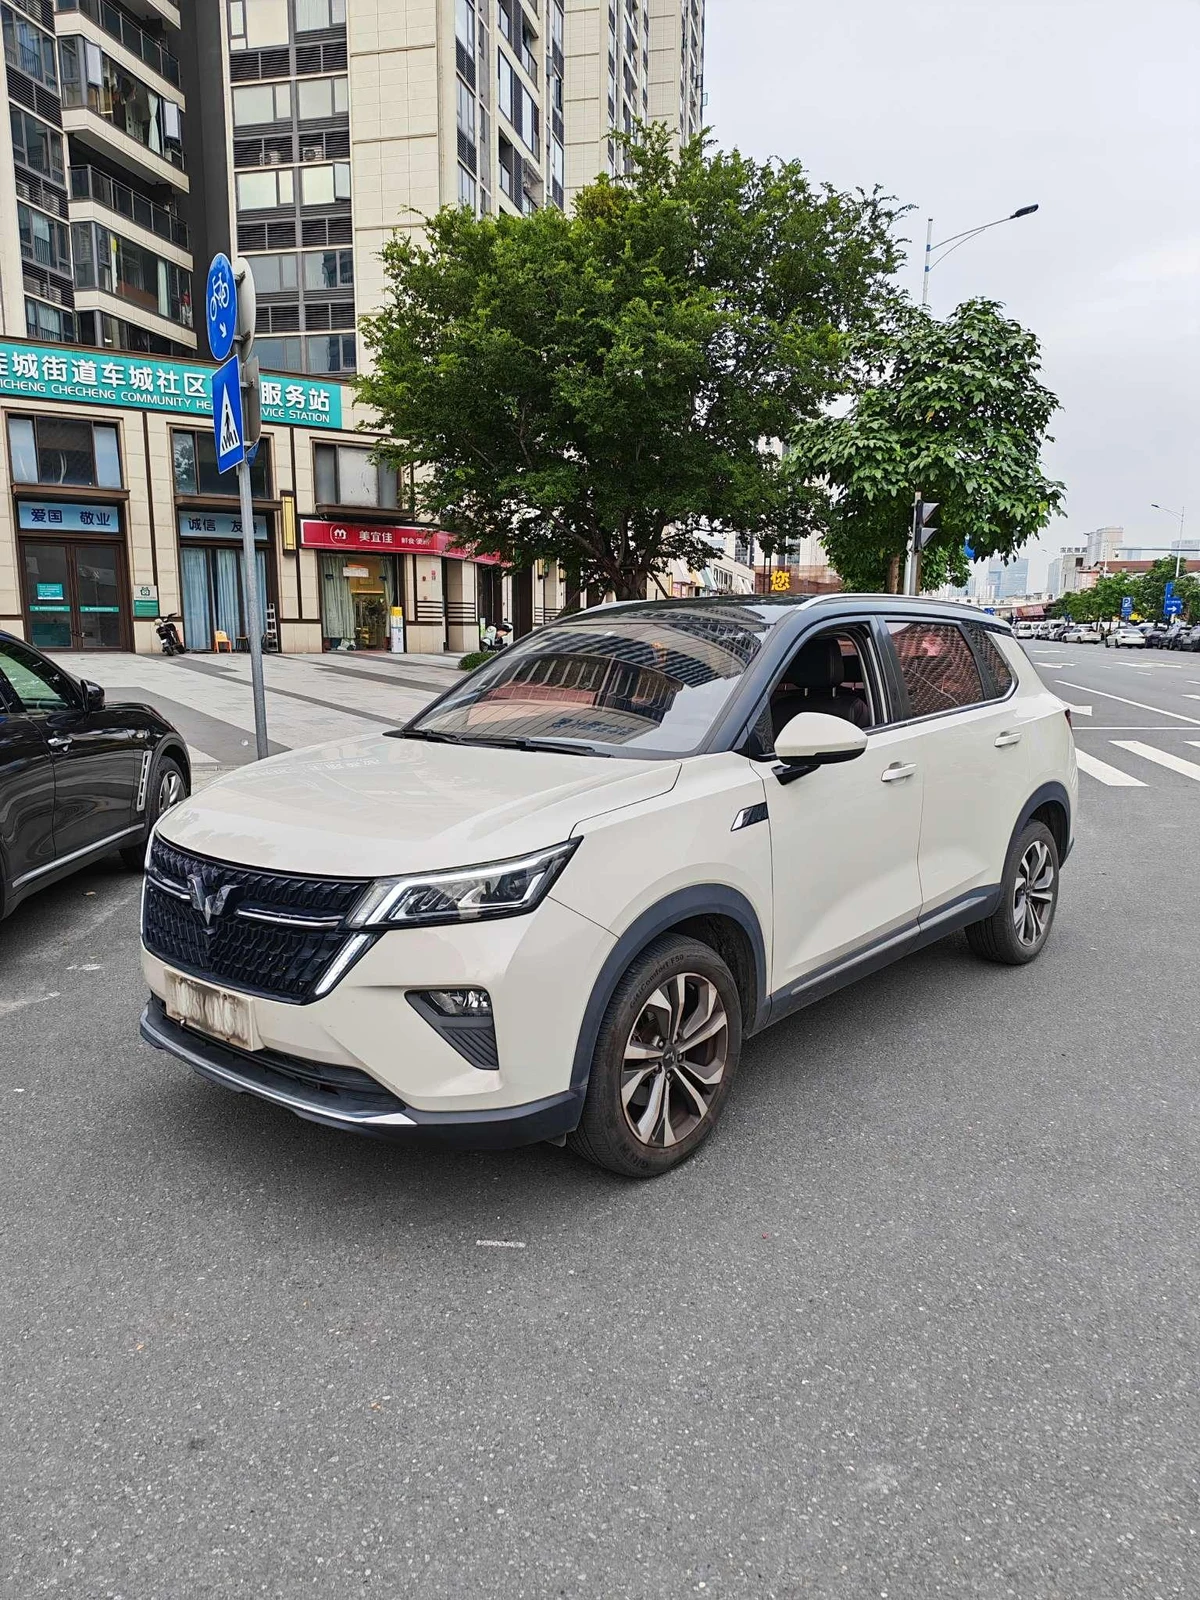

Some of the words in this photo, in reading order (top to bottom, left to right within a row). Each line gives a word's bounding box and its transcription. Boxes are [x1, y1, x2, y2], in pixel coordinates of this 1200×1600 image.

[0, 351, 213, 398] 城街道车城社区
[261, 381, 331, 412] 服务站
[51, 384, 116, 400] CHECHENG
[121, 391, 192, 408] COMMUNITY
[196, 400, 213, 411] HE
[260, 407, 285, 418] VICE
[289, 409, 330, 423] STATION
[31, 508, 63, 523] 爱国
[80, 511, 111, 526] 敬业
[187, 517, 216, 532] 诚信
[231, 519, 257, 534] 友
[359, 530, 393, 544] 美宜佳
[770, 570, 790, 591] 您
